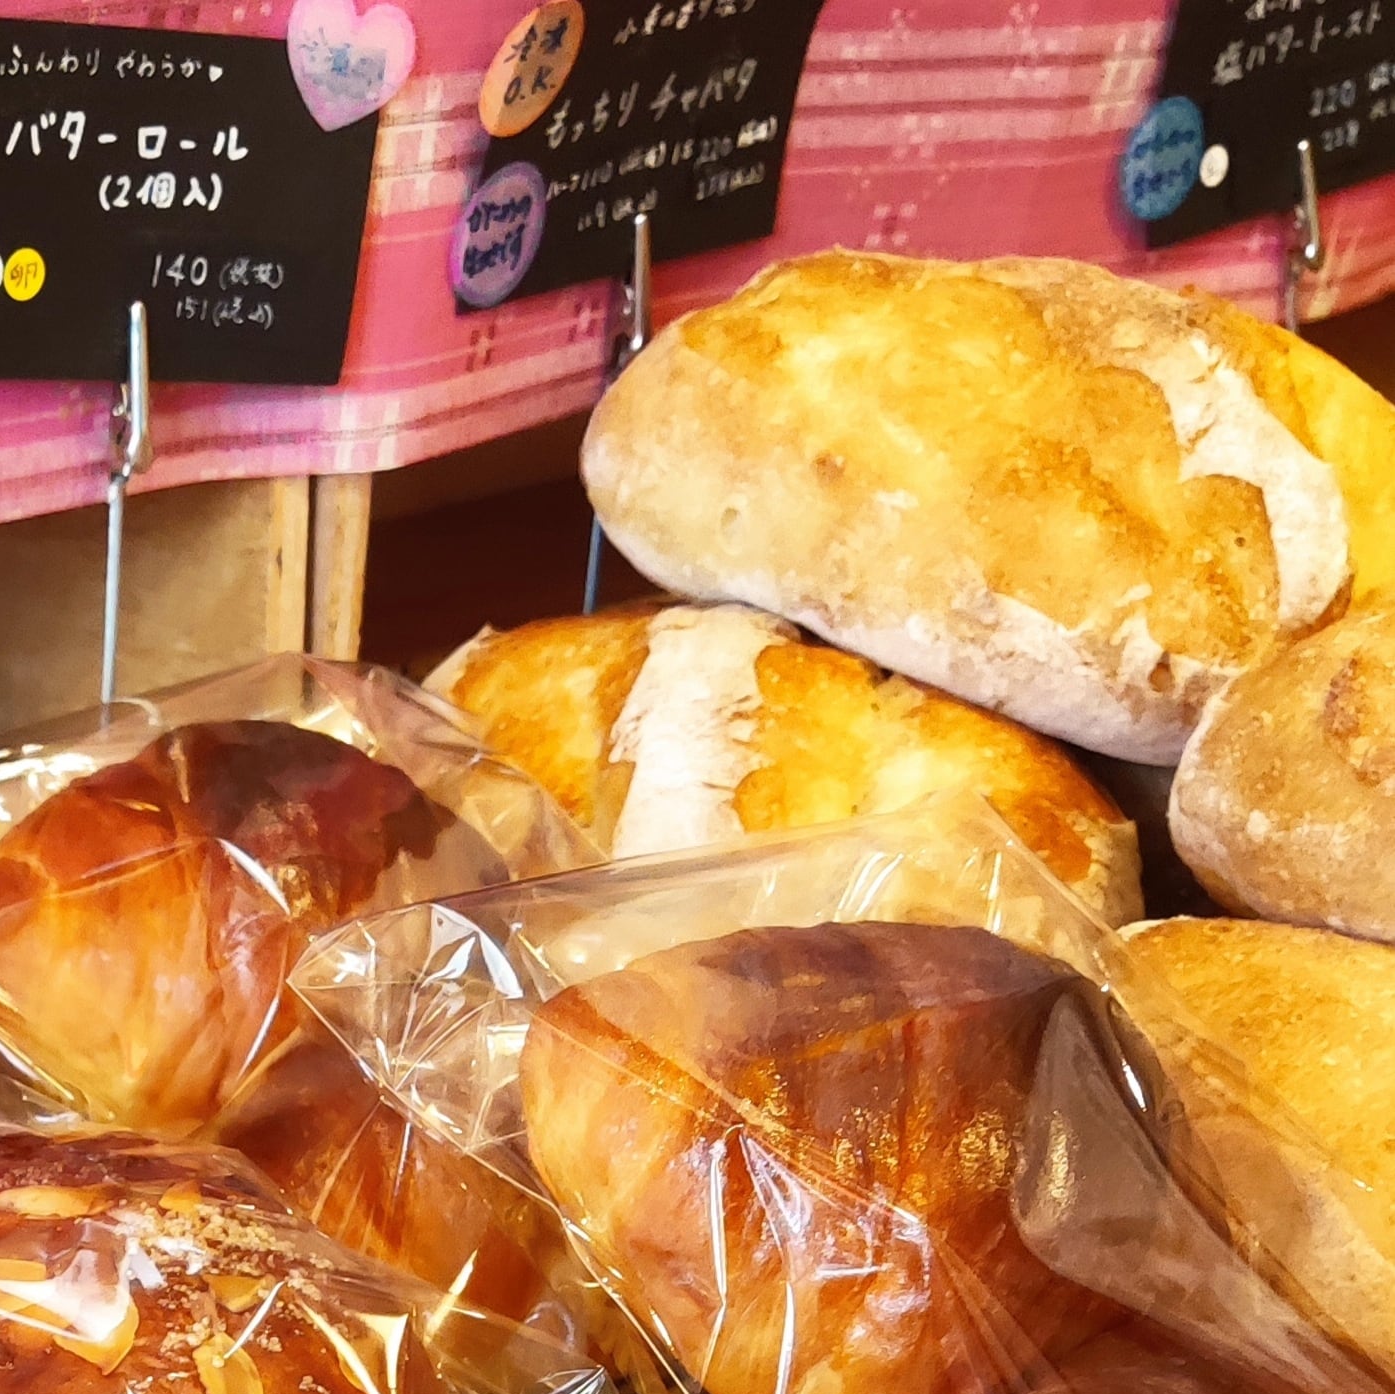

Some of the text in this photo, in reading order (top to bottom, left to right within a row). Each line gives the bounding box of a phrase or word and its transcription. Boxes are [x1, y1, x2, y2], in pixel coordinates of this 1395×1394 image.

[0, 45, 100, 77] ふんわり
[5, 111, 249, 161] バターロール
